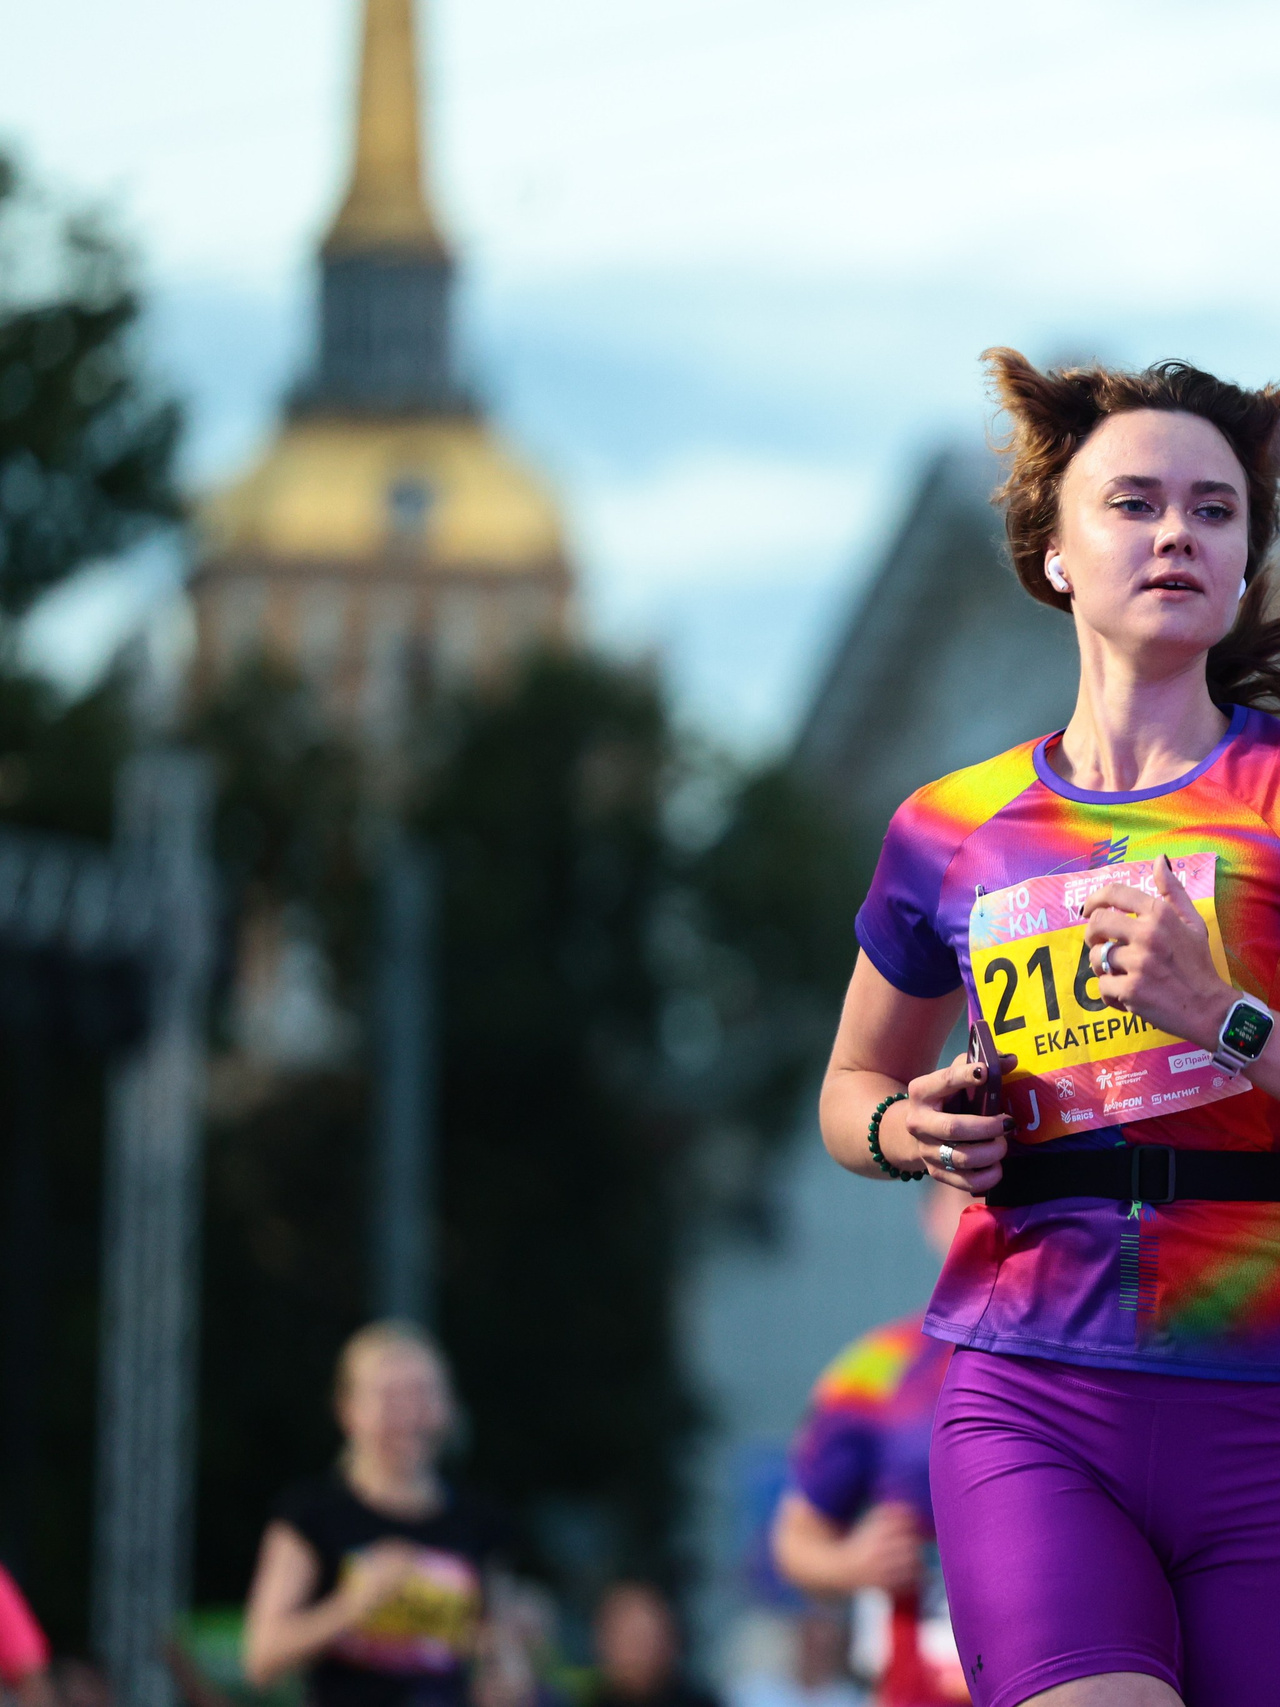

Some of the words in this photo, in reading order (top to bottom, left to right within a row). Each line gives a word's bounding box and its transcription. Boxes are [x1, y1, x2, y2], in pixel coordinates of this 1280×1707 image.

[1064, 870, 1131, 889] СБЕРПРАЙМ
[1007, 886, 1030, 912] 10
[1009, 907, 1049, 938] КМ
[985, 938, 1111, 1037] 216
[1035, 1013, 1157, 1055] ЕКАТЕРИН
[1163, 1086, 1200, 1101] МАГНИТ
[1026, 1089, 1040, 1131] J
[1072, 1111, 1094, 1122] BRICS
